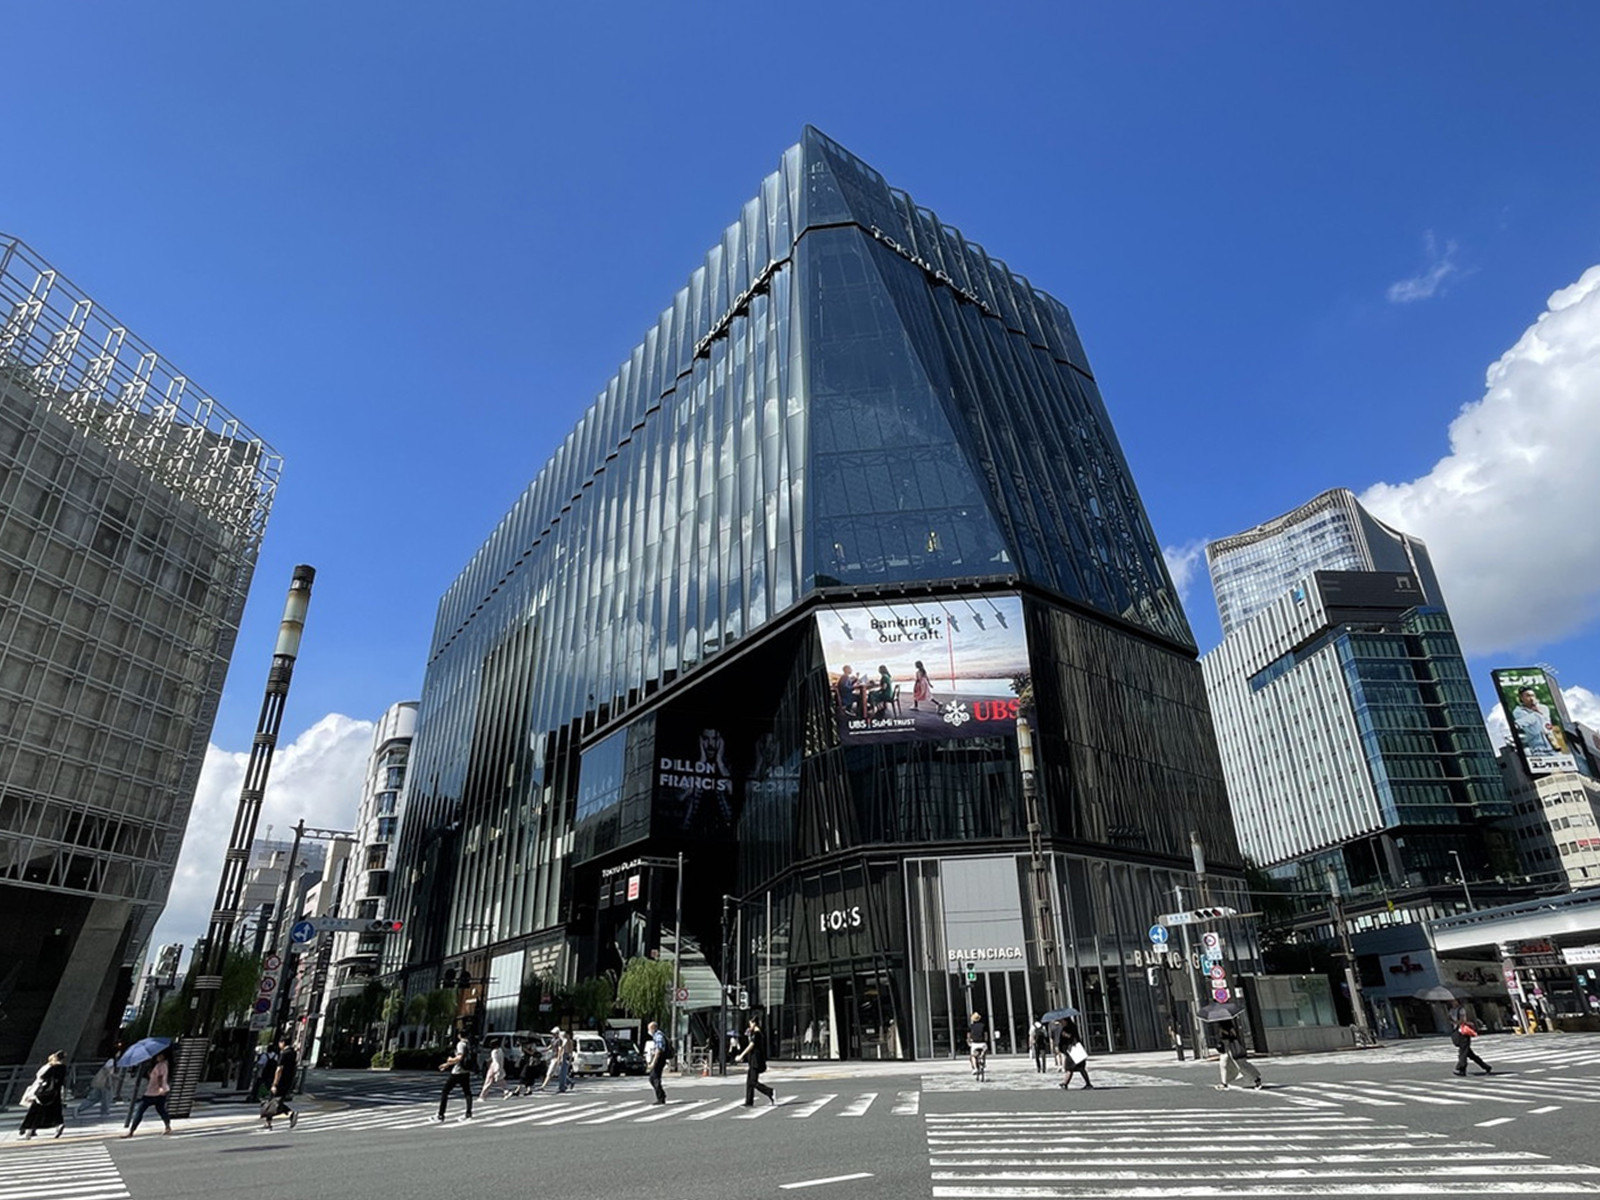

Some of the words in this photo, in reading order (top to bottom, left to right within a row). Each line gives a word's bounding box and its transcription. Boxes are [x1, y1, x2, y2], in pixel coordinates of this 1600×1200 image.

[870, 613, 928, 630] Banking
[930, 613, 942, 626] is
[878, 632, 902, 643] our
[906, 627, 943, 641] craft.
[972, 698, 1020, 721] UBS
[848, 719, 867, 729] UBS
[660, 757, 716, 774] DILLON
[659, 773, 726, 791] FRANCIS
[948, 946, 1023, 960] BALENCIAGA
